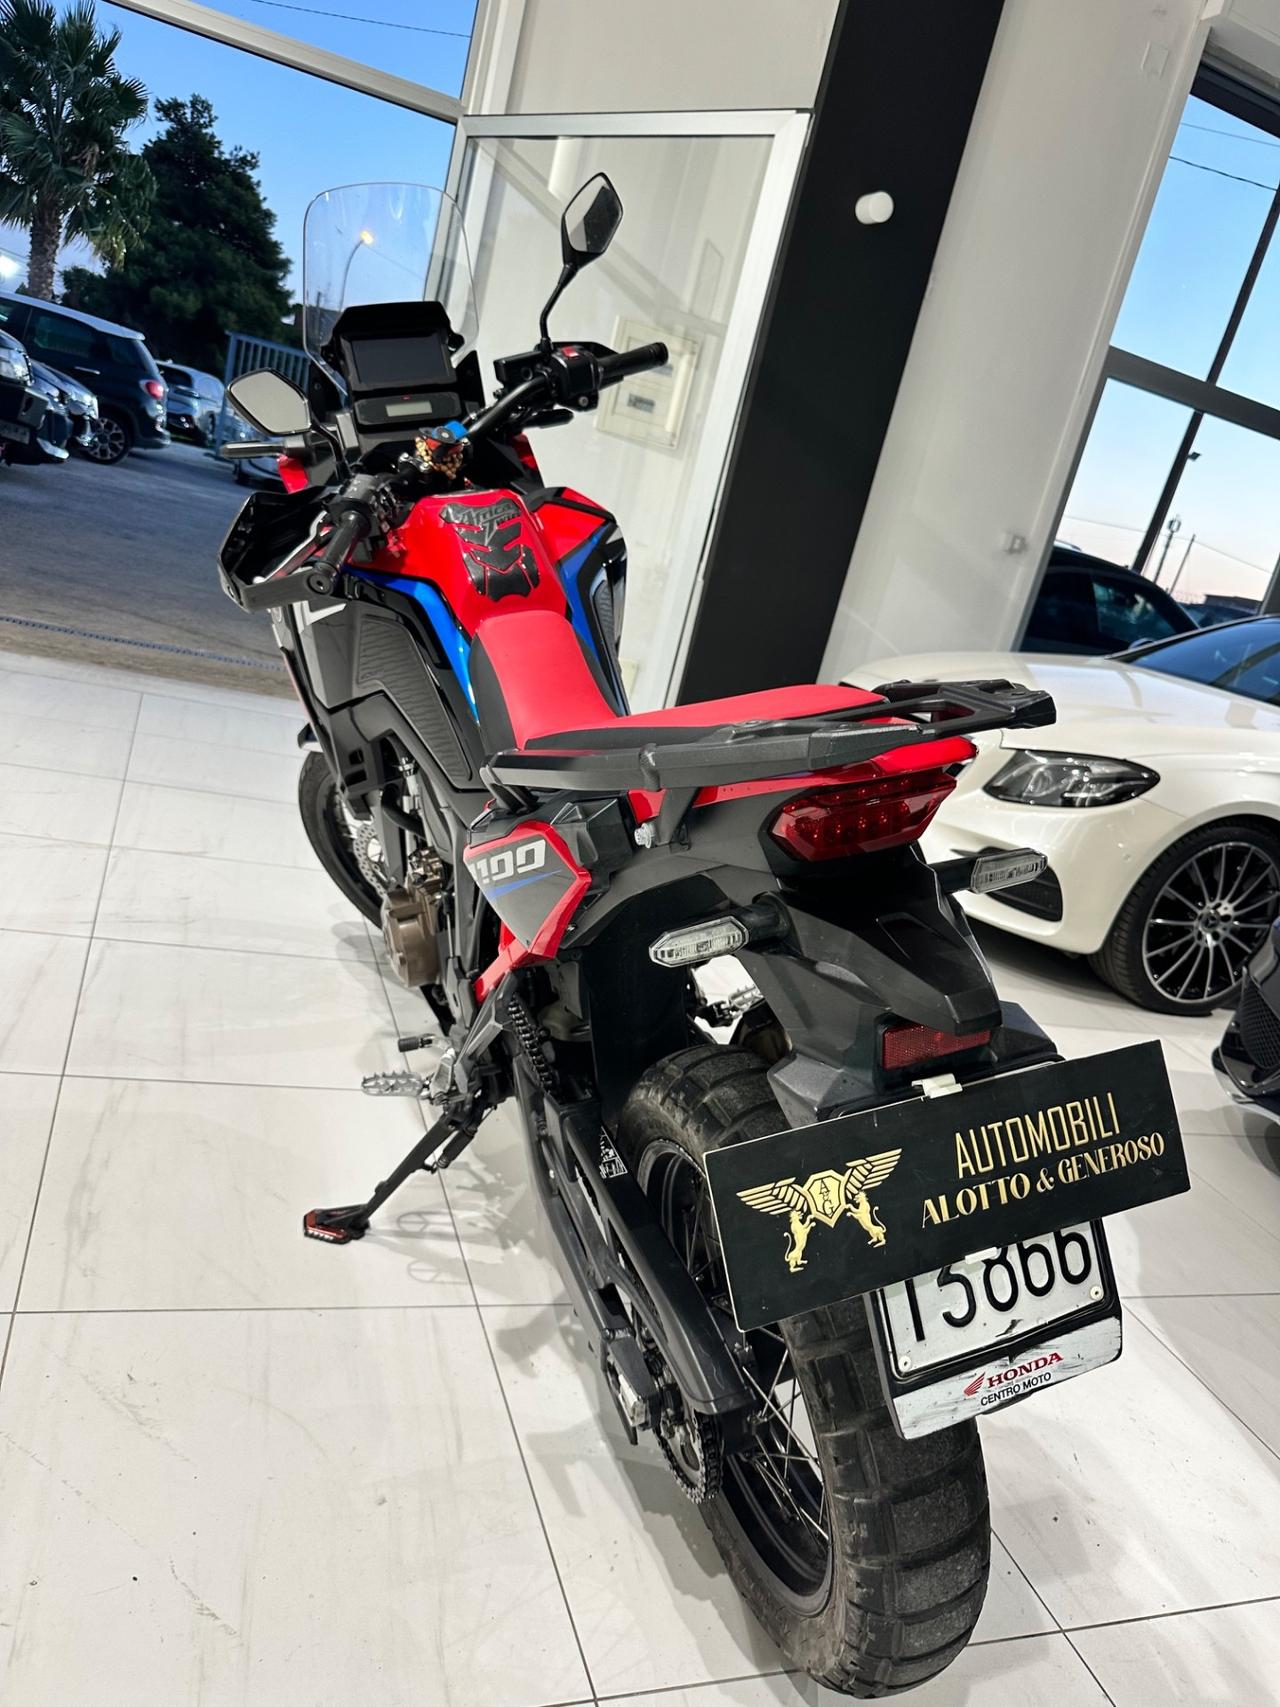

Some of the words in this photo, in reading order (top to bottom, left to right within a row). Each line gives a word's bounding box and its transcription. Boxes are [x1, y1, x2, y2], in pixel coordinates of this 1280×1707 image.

[955, 1092, 1121, 1179] AUTOMOBILI
[922, 1173, 1031, 1229] ALOTTO
[1036, 1167, 1055, 1193] &
[1058, 1132, 1165, 1184] GENEROSO
[980, 1385, 1021, 1406] CENTRO
[1022, 1371, 1052, 1391] MOTO
[987, 1352, 1064, 1388] HONDA
